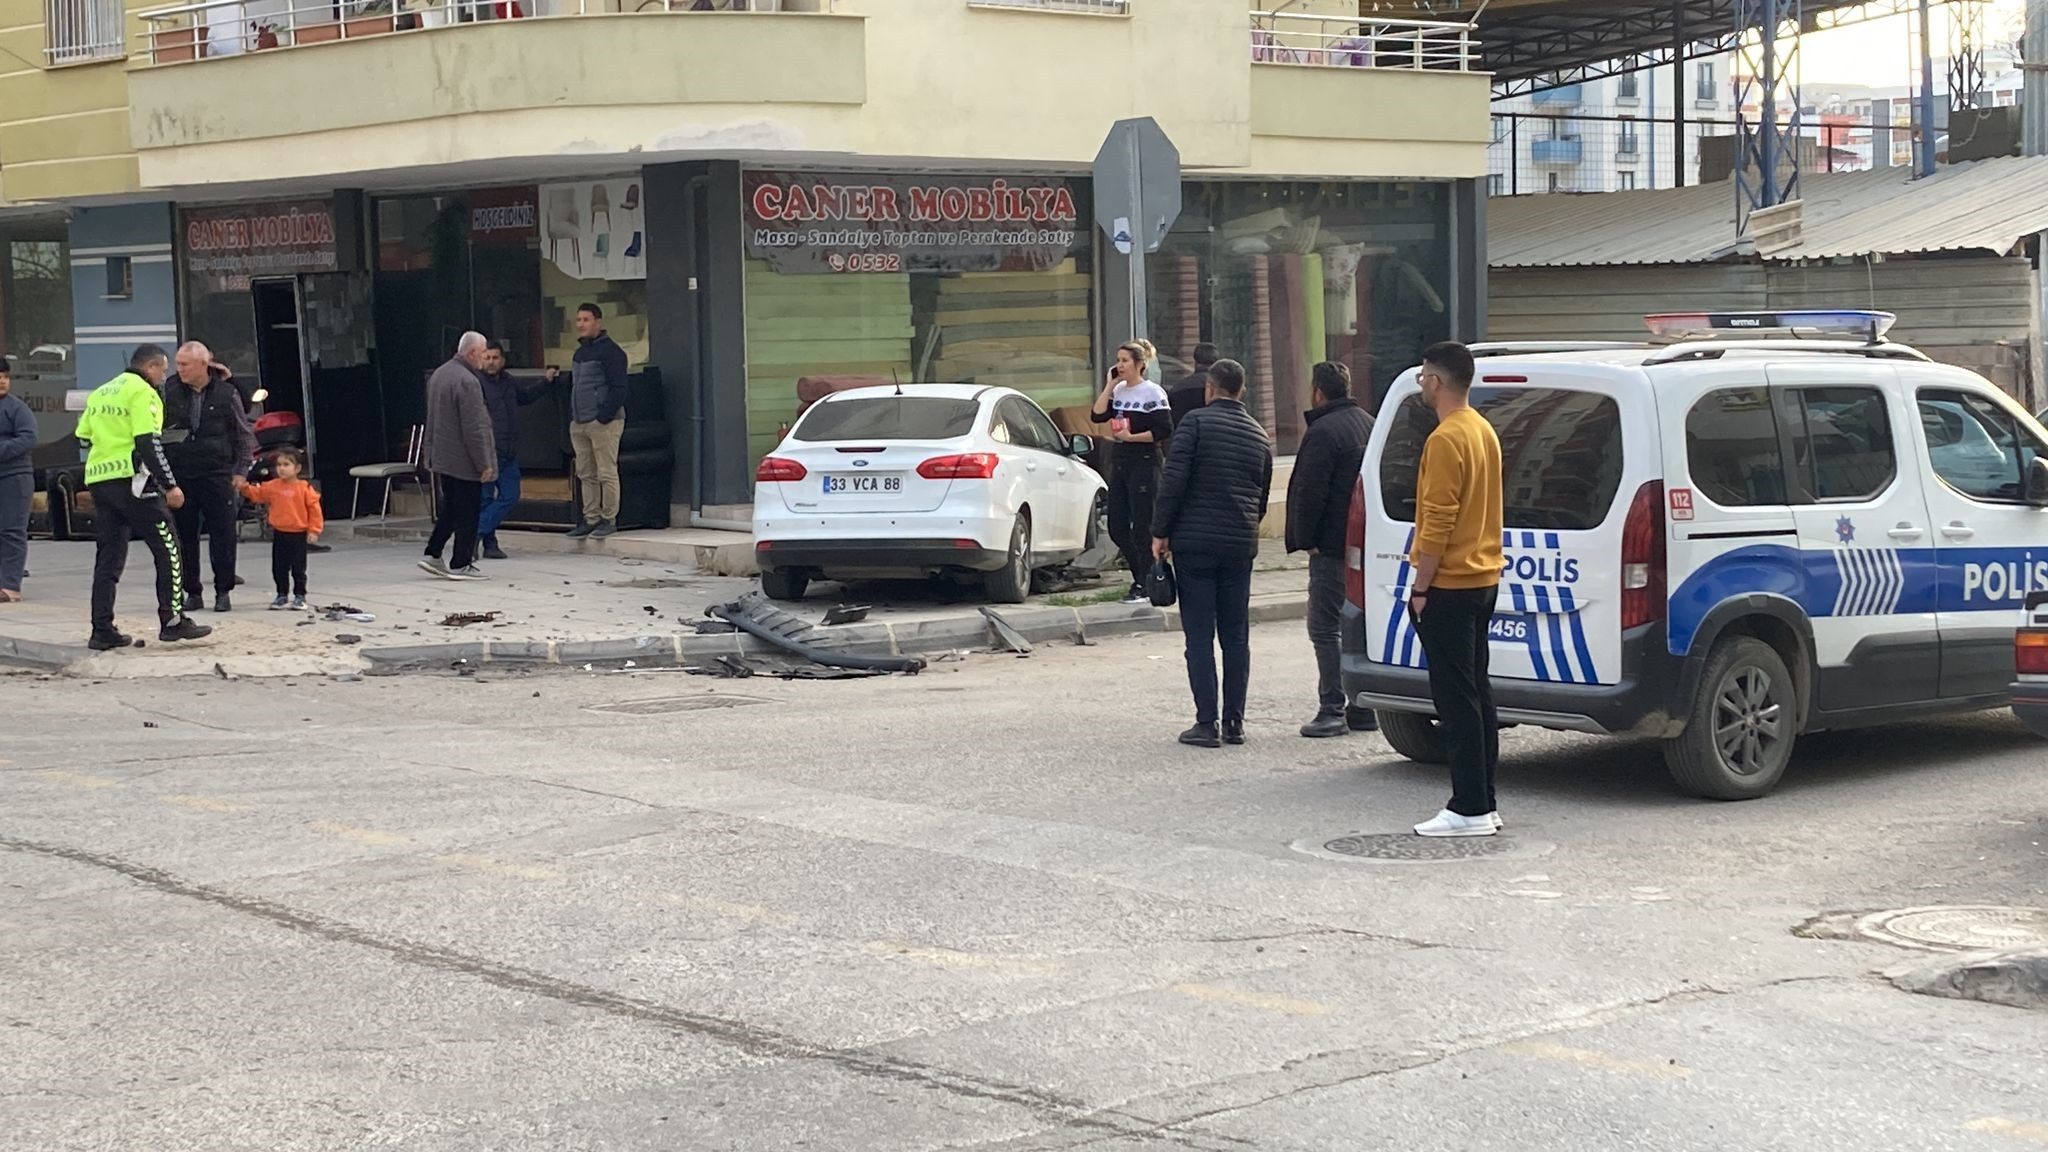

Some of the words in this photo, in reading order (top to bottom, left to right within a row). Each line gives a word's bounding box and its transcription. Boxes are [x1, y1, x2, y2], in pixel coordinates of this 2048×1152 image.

[754, 184, 900, 221] CANER
[909, 179, 1076, 221] MOBİLYA
[188, 219, 249, 250] CANER
[252, 206, 335, 248] MOBİLYA
[754, 229, 797, 246] Masa
[808, 229, 880, 248] Sandalye
[884, 229, 934, 248] Toptan
[940, 232, 957, 245] ve
[960, 229, 1036, 245] Perakende
[1039, 229, 1075, 247] Satış
[849, 253, 900, 271] 0532
[831, 478, 846, 490] 33
[853, 478, 878, 490] VCA
[884, 477, 900, 490] 88
[1672, 492, 1690, 507] 112
[1500, 551, 1579, 583] POLİS
[1963, 551, 2048, 601] POLİS
[1488, 619, 1527, 638] 456
